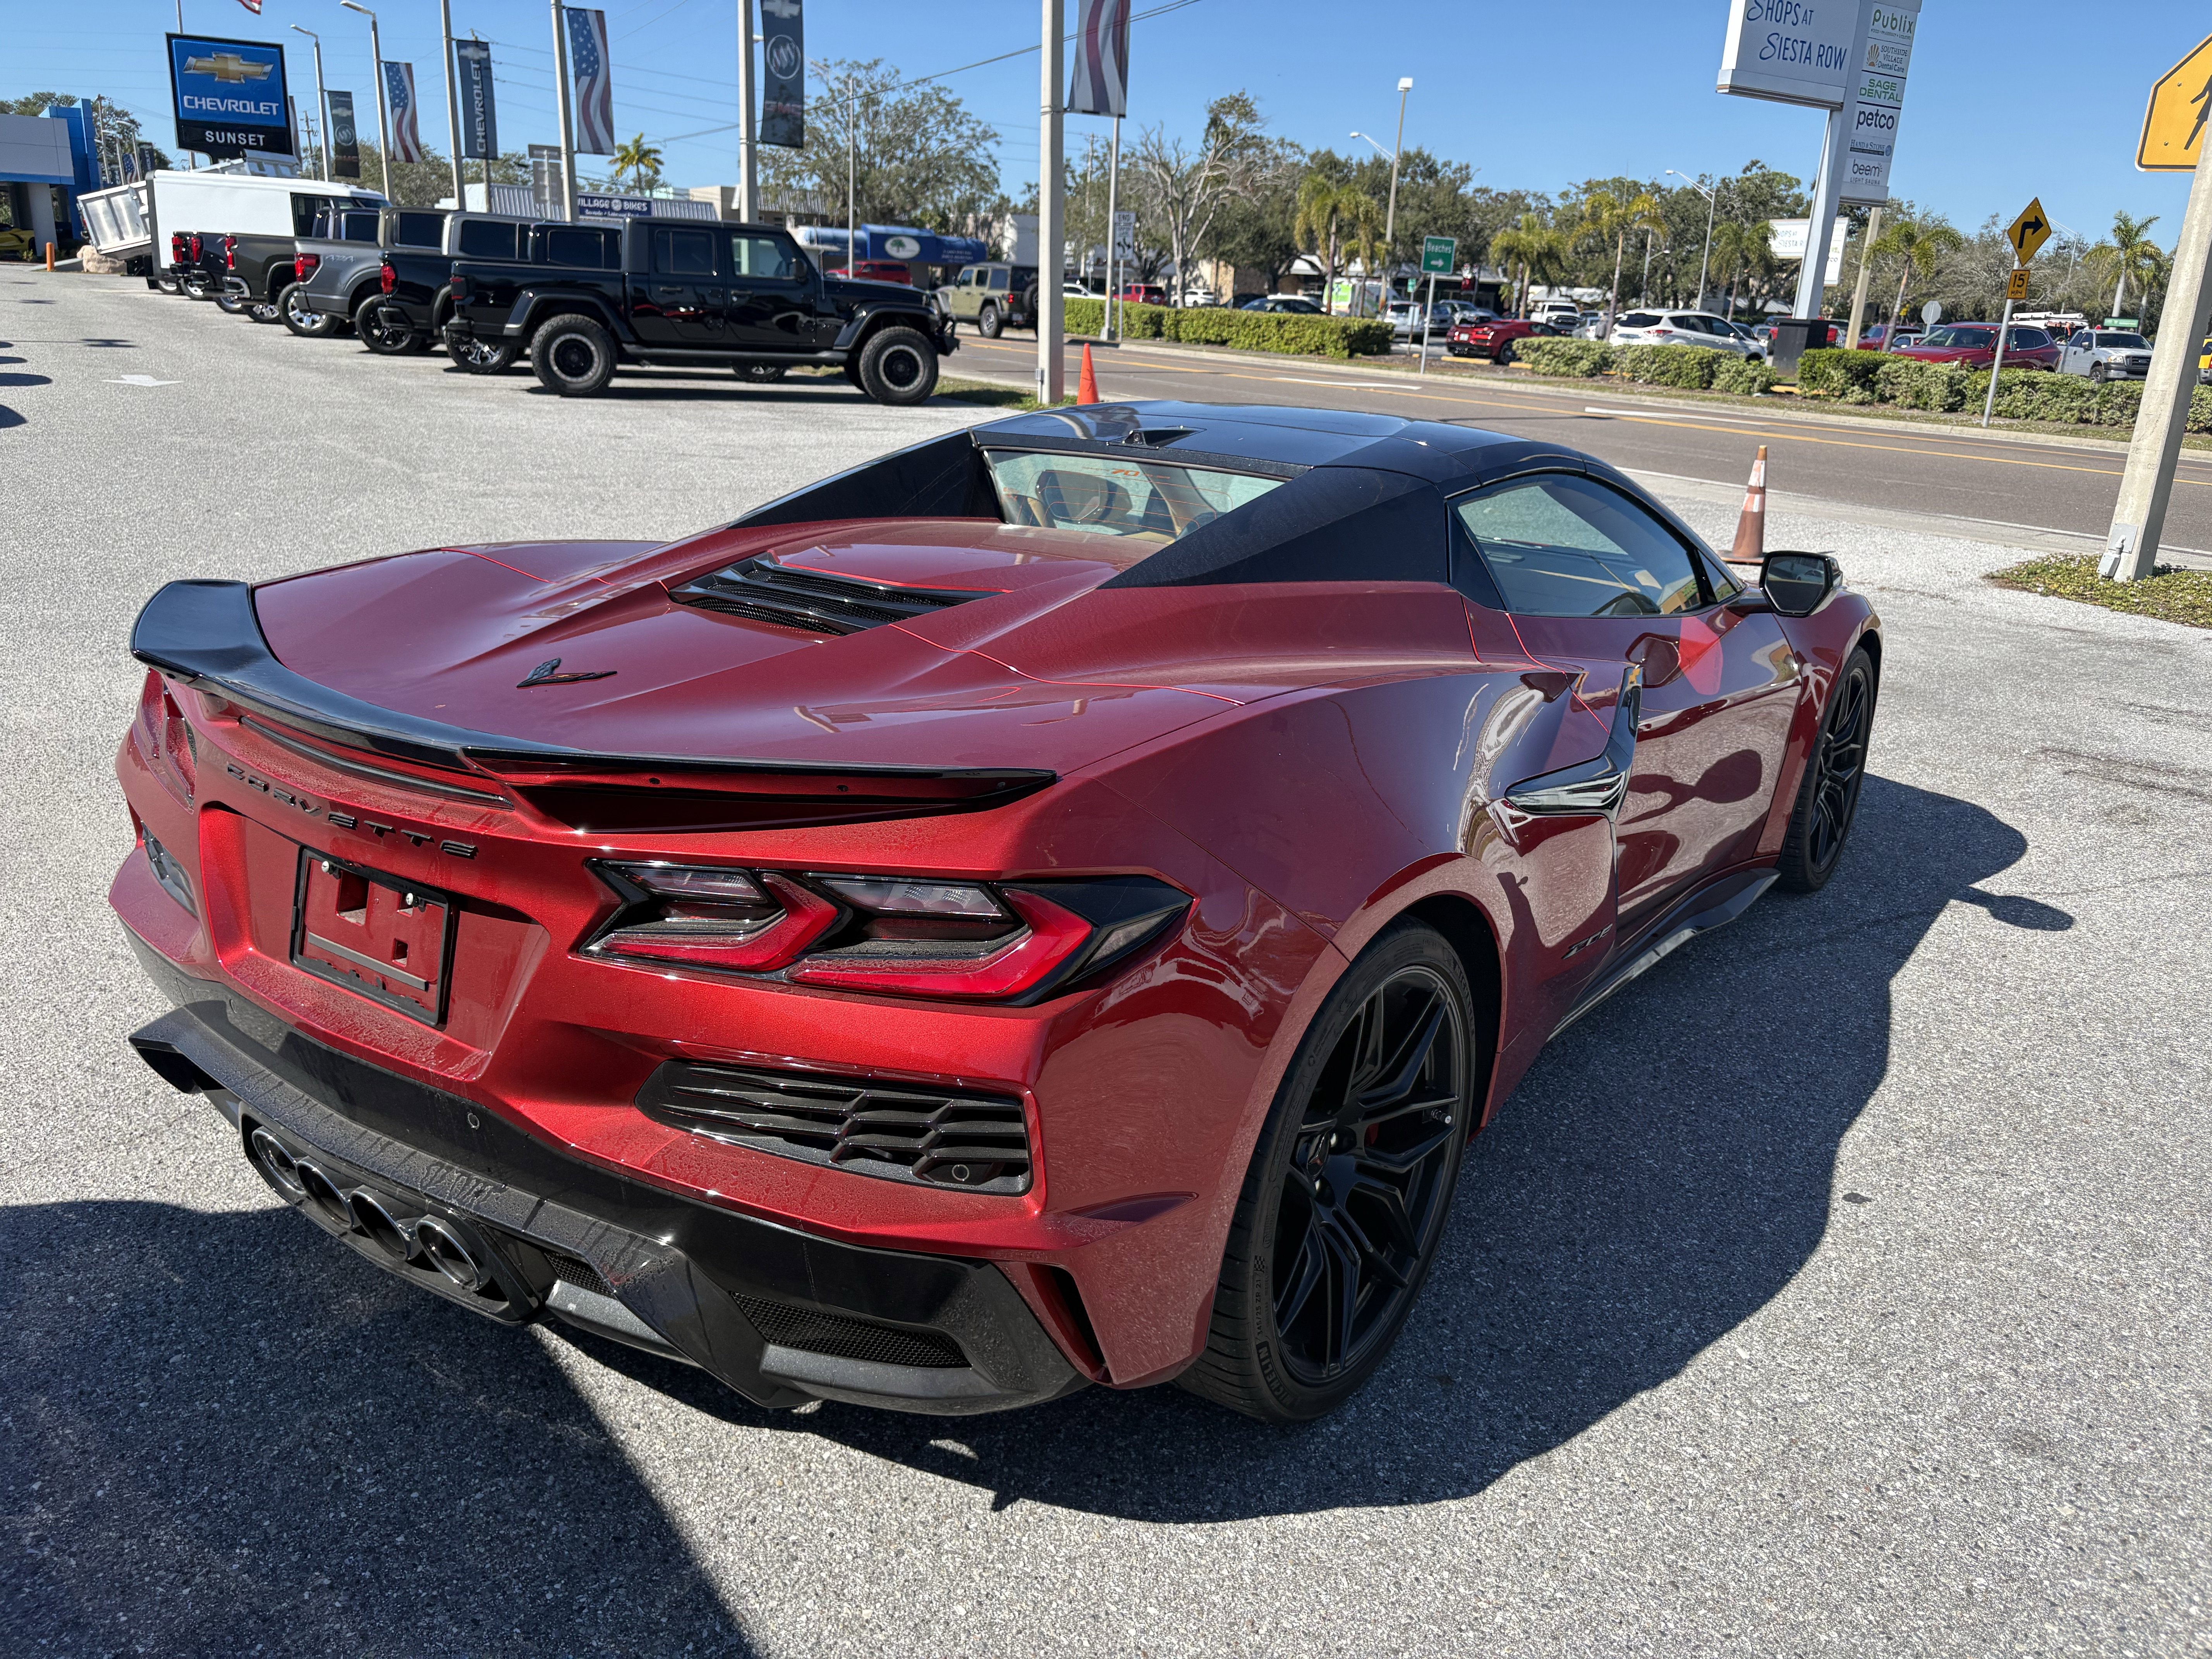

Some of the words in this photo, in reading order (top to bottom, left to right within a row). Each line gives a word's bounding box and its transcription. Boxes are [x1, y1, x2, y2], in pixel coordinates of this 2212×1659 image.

[1747, 0, 1800, 26] SHOPS
[1802, 9, 1814, 25] AT
[1872, 9, 1913, 33] Publix
[1759, 33, 1812, 65] SIESTA
[1816, 44, 1847, 70] ROW
[1881, 45, 1908, 57] SOUTHSIDE
[1883, 53, 1903, 64] VILLAGE
[1878, 61, 1893, 70] Dental
[1894, 64, 1905, 72] Care
[1868, 79, 1897, 91] SAGE
[1859, 87, 1901, 102] DENTAL
[184, 96, 279, 115] CHEVROLET
[471, 60, 486, 153] CHEVROLET
[1856, 109, 1894, 130] petco
[205, 131, 265, 146] SUNSET
[1853, 159, 1880, 177] beem
[623, 201, 647, 211] BIKES
[1427, 242, 1452, 254] Beaches
[2013, 273, 2026, 288] 15
[227, 764, 478, 859] CORVETTE
[1255, 1279, 1261, 1288] 21
[1255, 1291, 1261, 1304] ZR
[1259, 1346, 1295, 1408] MICHELIN
